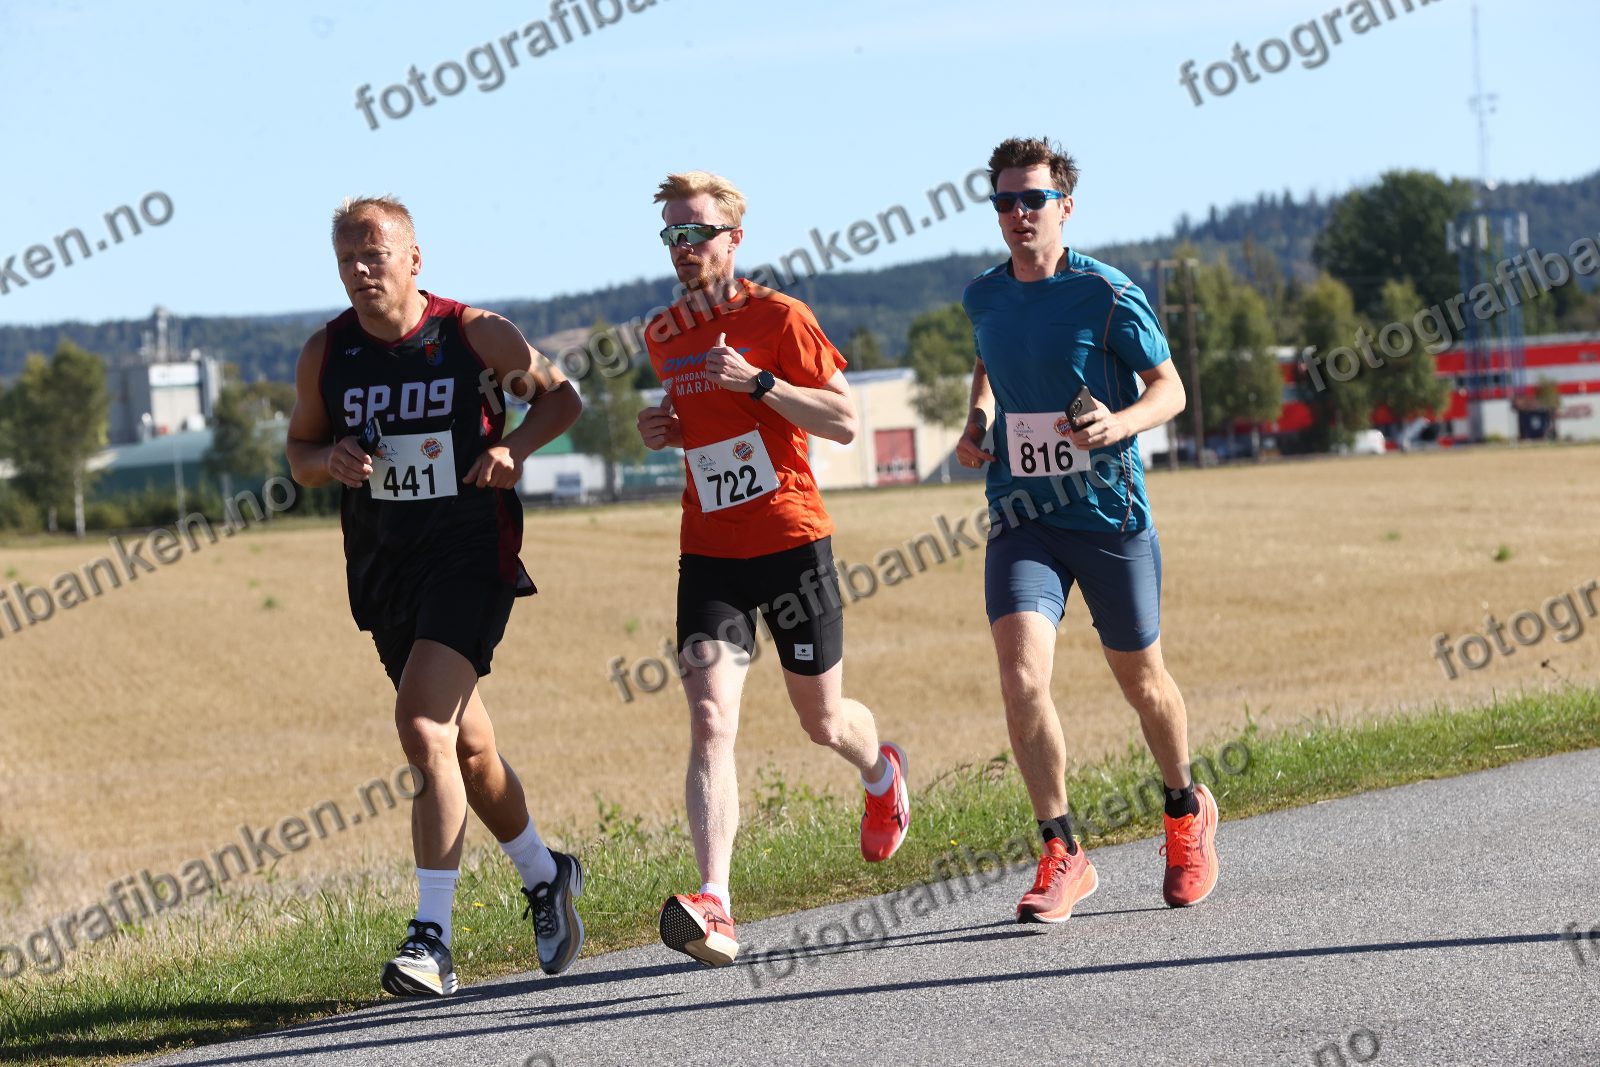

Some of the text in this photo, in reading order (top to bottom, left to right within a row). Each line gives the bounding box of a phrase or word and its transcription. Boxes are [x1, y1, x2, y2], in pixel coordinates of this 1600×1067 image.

[343, 377, 455, 427] SP.09
[1020, 440, 1074, 474] 816
[383, 463, 436, 498] 441
[706, 464, 763, 506] 722
